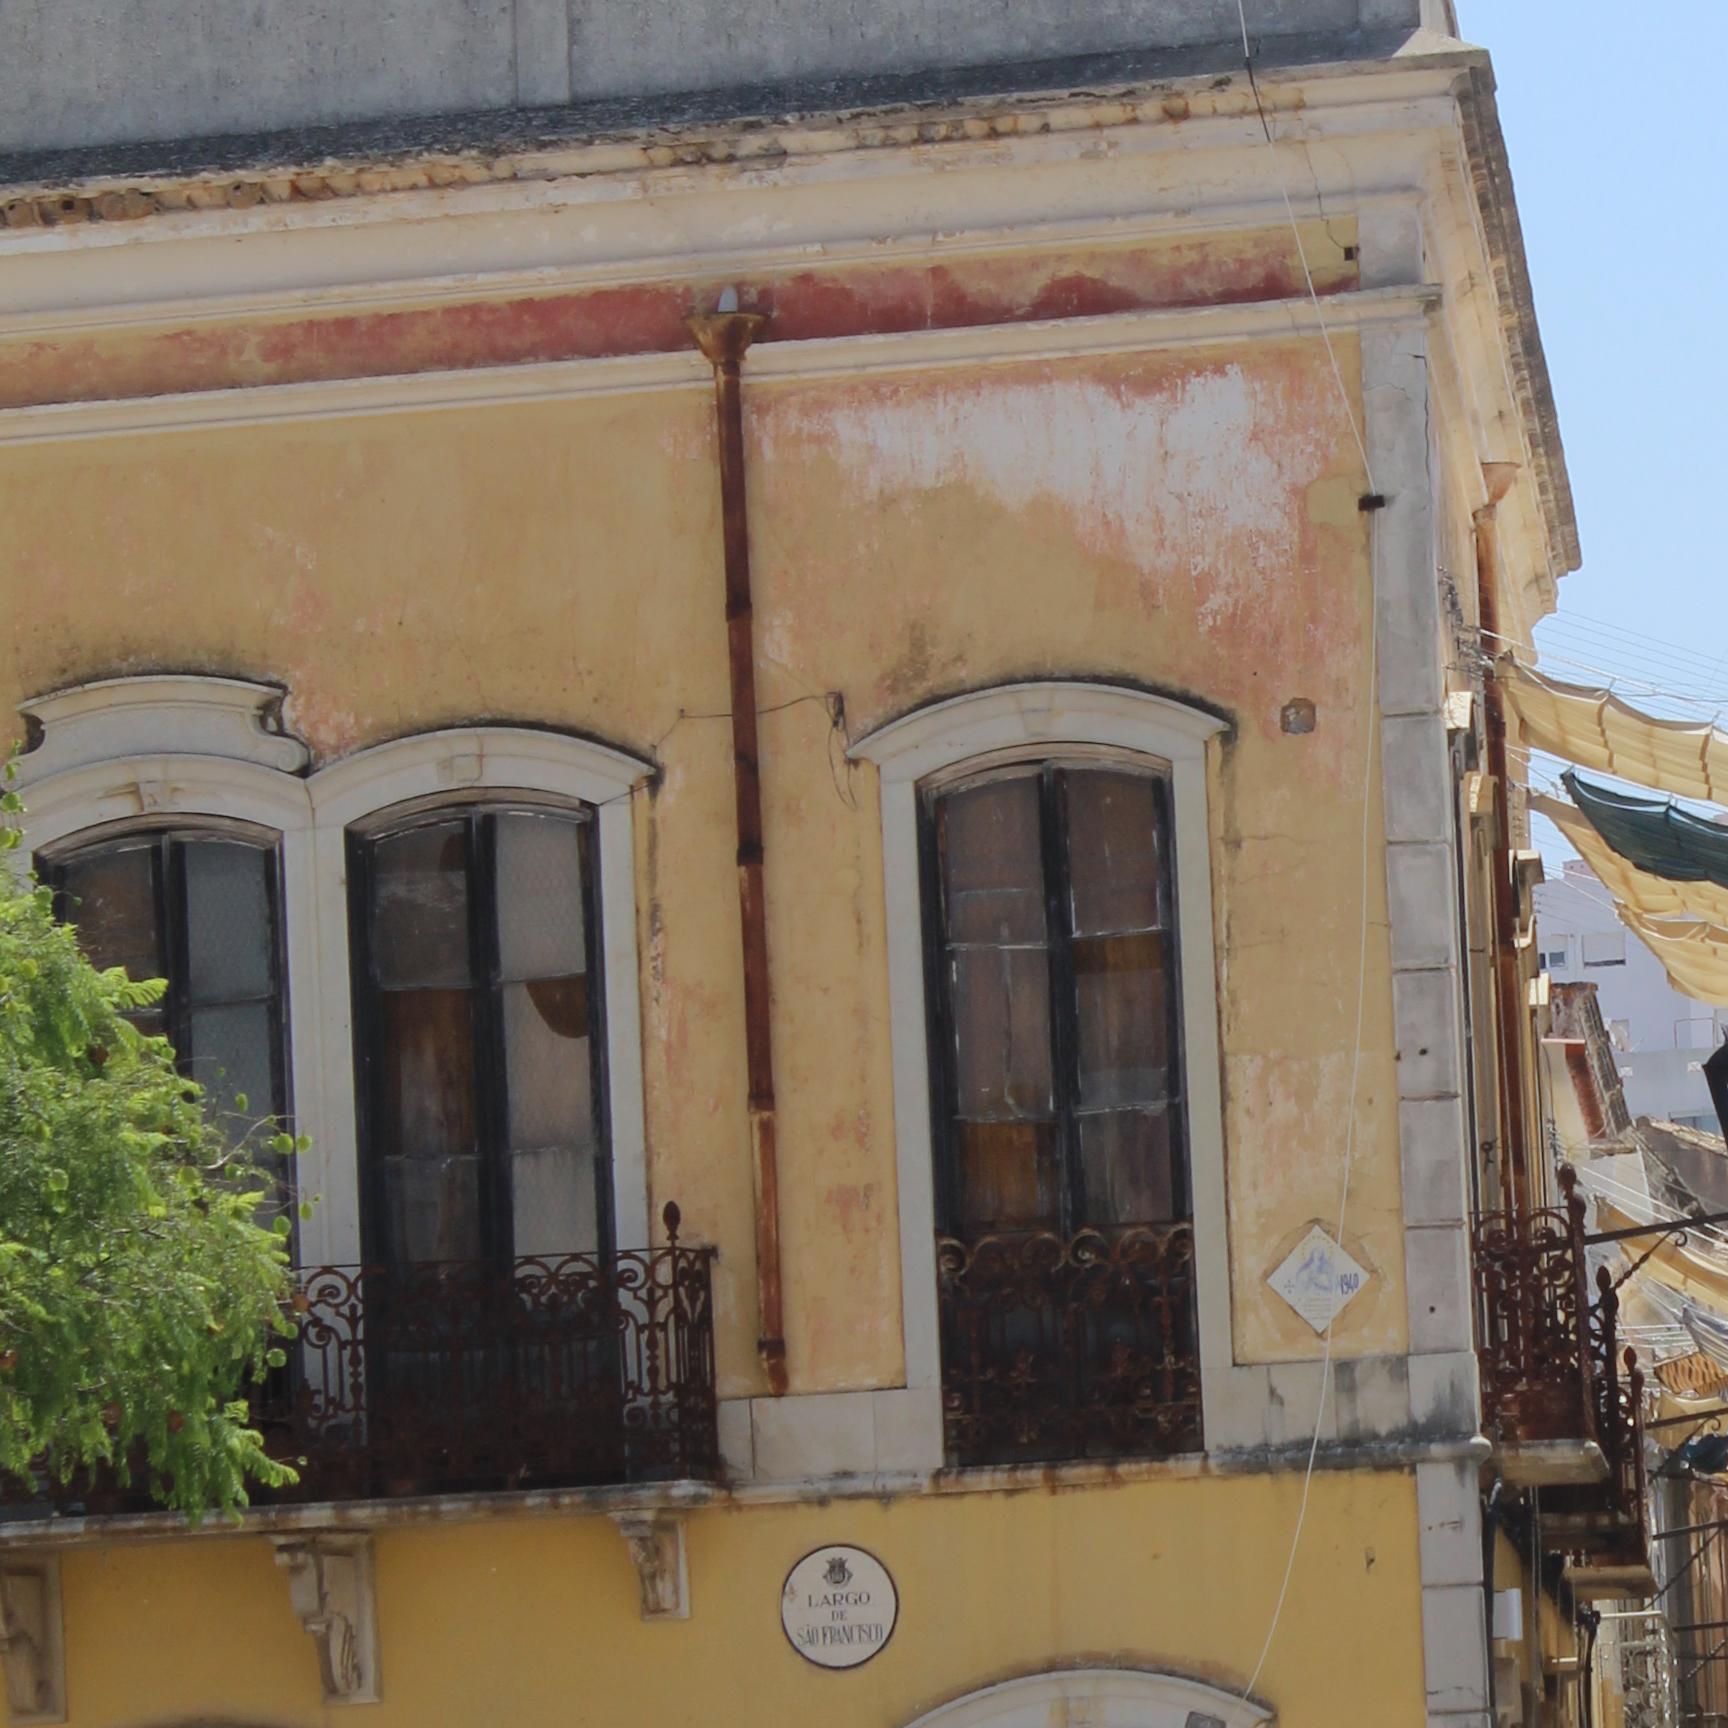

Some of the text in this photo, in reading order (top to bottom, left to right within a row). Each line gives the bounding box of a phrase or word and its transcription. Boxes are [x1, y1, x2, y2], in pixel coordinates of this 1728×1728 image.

[808, 1591, 870, 1608] LARGO
[831, 1610, 848, 1622] DE
[797, 1623, 884, 1646] SÃO FRANCISCO
